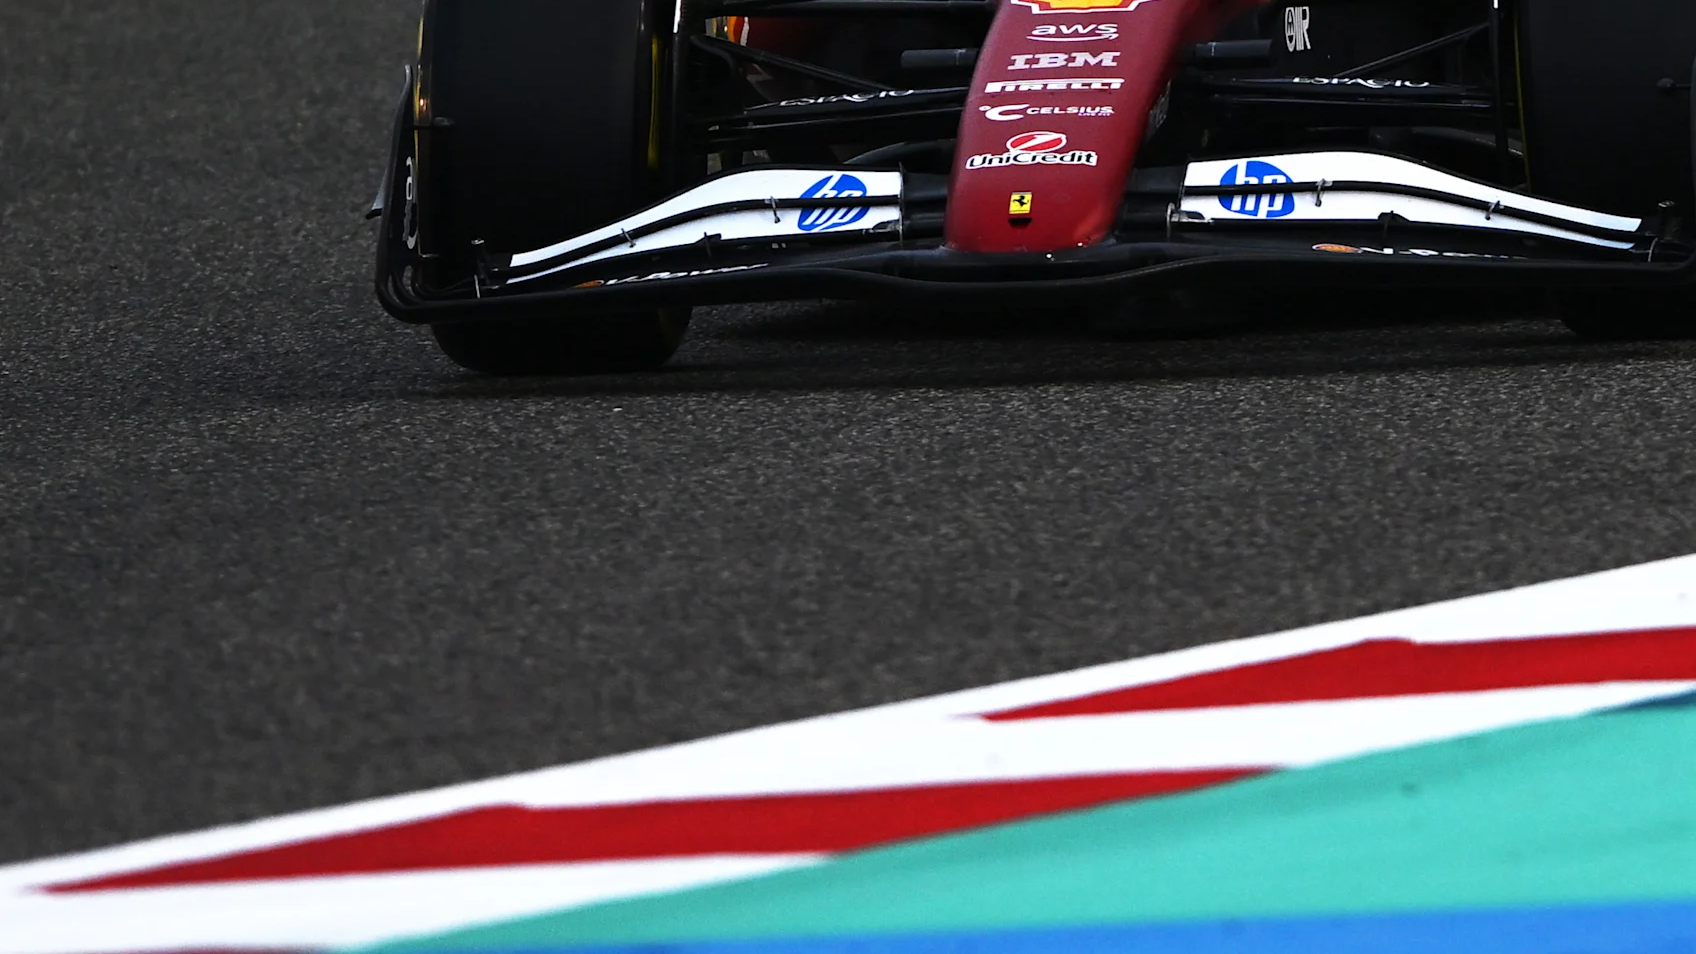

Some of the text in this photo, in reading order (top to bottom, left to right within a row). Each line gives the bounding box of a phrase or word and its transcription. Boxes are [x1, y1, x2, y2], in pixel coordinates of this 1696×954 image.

[1031, 23, 1118, 37] aws
[1007, 52, 1121, 70] IBM
[984, 78, 1125, 93] PIRELLI
[1026, 106, 1115, 115] CELSIUS
[967, 151, 1095, 168] UniCredit
[1224, 160, 1291, 218] hp
[800, 174, 867, 230] hp
